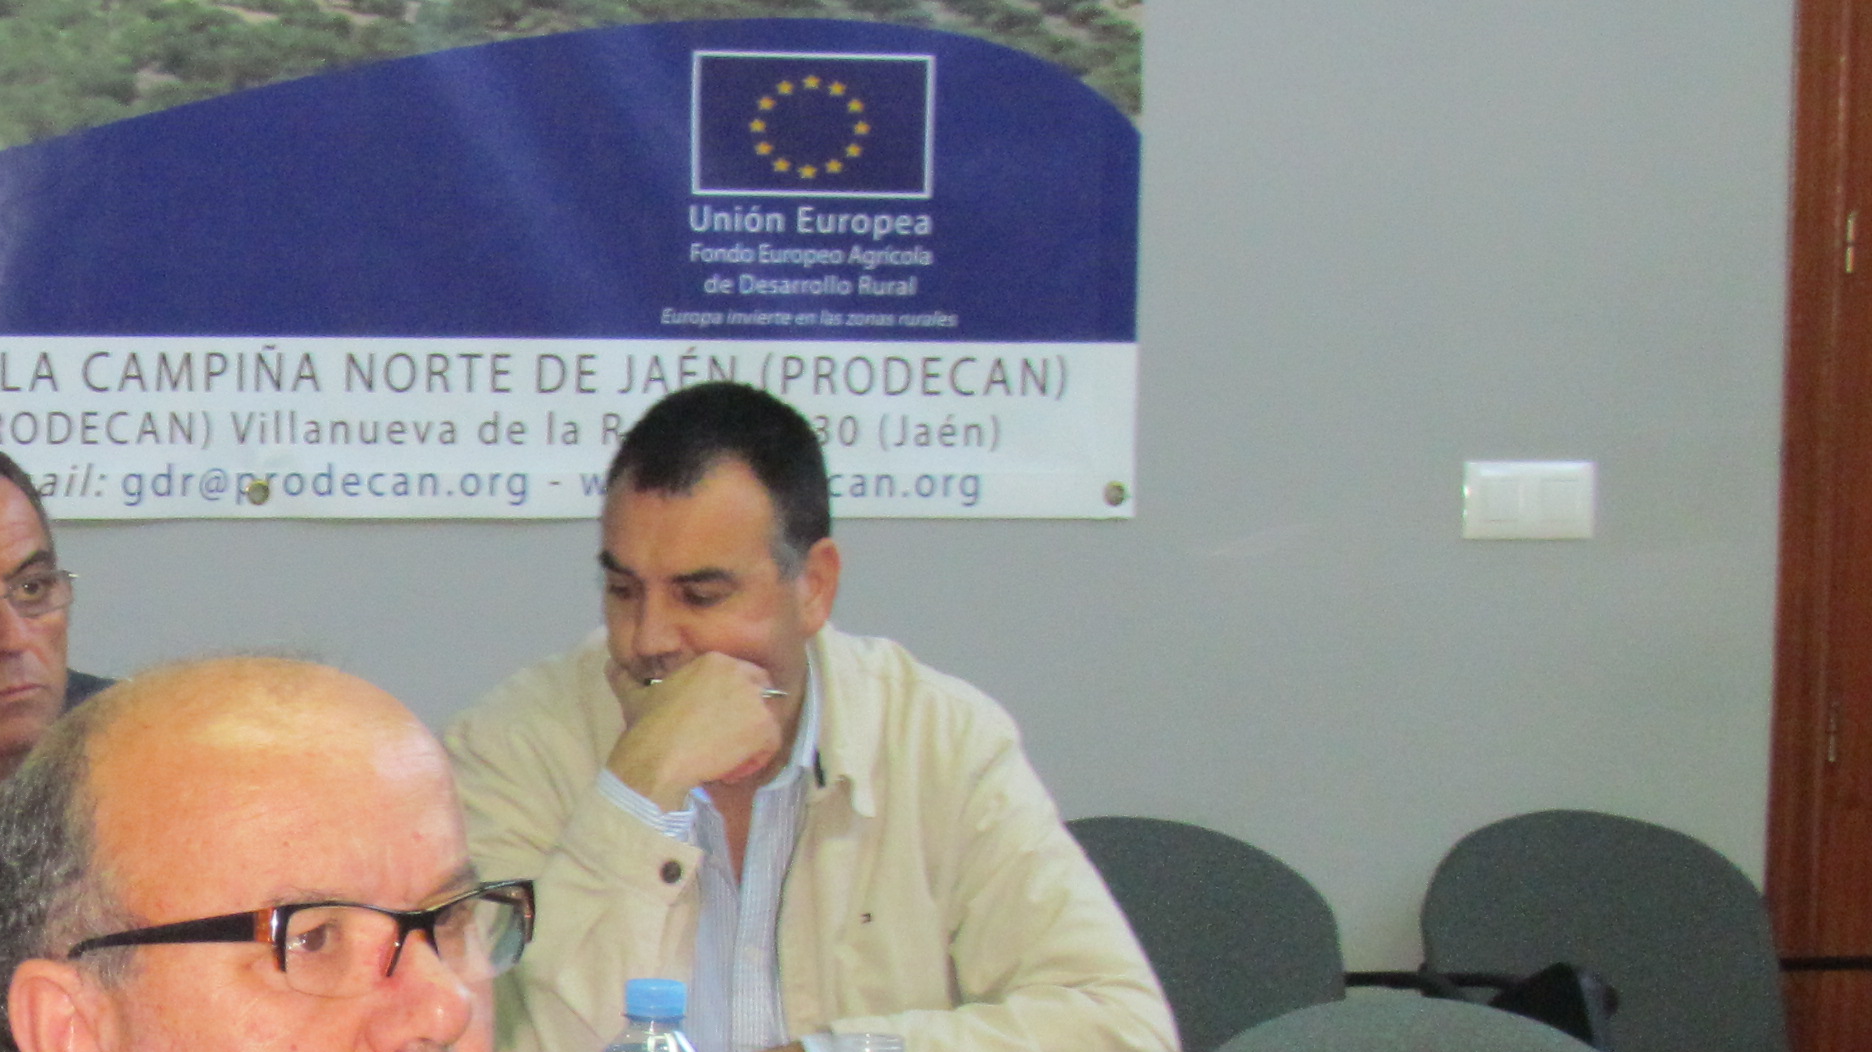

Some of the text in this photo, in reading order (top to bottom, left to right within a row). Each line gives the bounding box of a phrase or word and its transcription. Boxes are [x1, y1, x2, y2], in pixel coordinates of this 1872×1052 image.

[688, 203, 933, 241] Unión Europea
[689, 243, 934, 271] Fondo Europeo Agrícola
[703, 272, 918, 296] de Desarrollo Rural
[660, 308, 724, 328] Europa
[727, 309, 792, 326] invierte
[795, 313, 818, 327] en
[845, 314, 895, 328] zonas
[898, 310, 960, 328] rurales
[0, 351, 59, 392] LA
[82, 344, 322, 392] CAMPIÑA
[344, 352, 512, 393] NORTE
[536, 353, 597, 394] DE
[617, 346, 736, 394] JAÉN
[760, 352, 1068, 401] (PRODECAN)
[230, 411, 457, 446] Villanueva
[478, 411, 526, 446] de
[546, 411, 580, 446] la
[879, 412, 1001, 452] (Jaén)
[121, 462, 529, 507] gdr@prodecan.org
